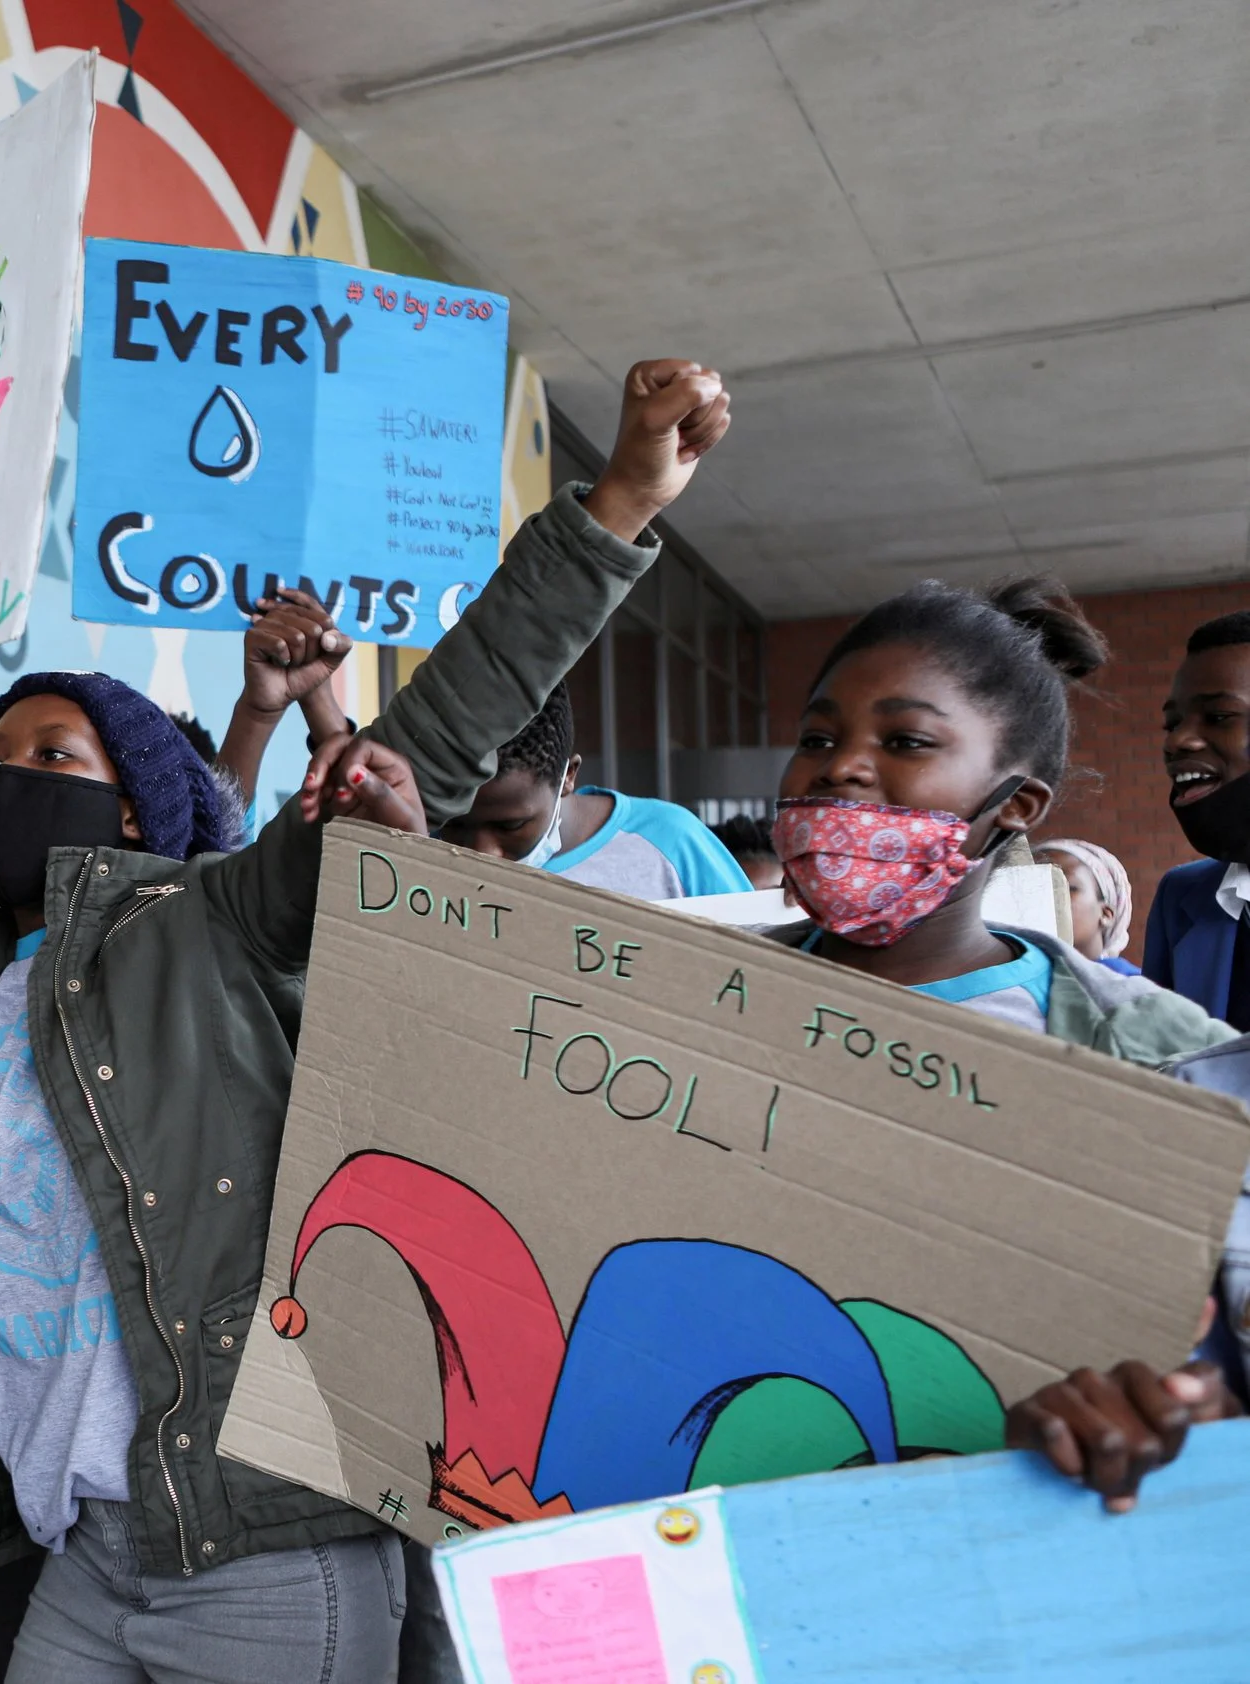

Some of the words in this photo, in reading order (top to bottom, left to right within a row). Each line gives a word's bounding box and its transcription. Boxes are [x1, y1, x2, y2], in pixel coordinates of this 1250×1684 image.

[113, 258, 353, 373] EVERY
[373, 285, 399, 312] 90
[404, 290, 430, 331] by
[434, 295, 494, 321] 2030
[358, 849, 513, 940] DON'T
[573, 924, 643, 980] BE
[713, 967, 748, 1014] A
[801, 1003, 1000, 1112] FOSSIL
